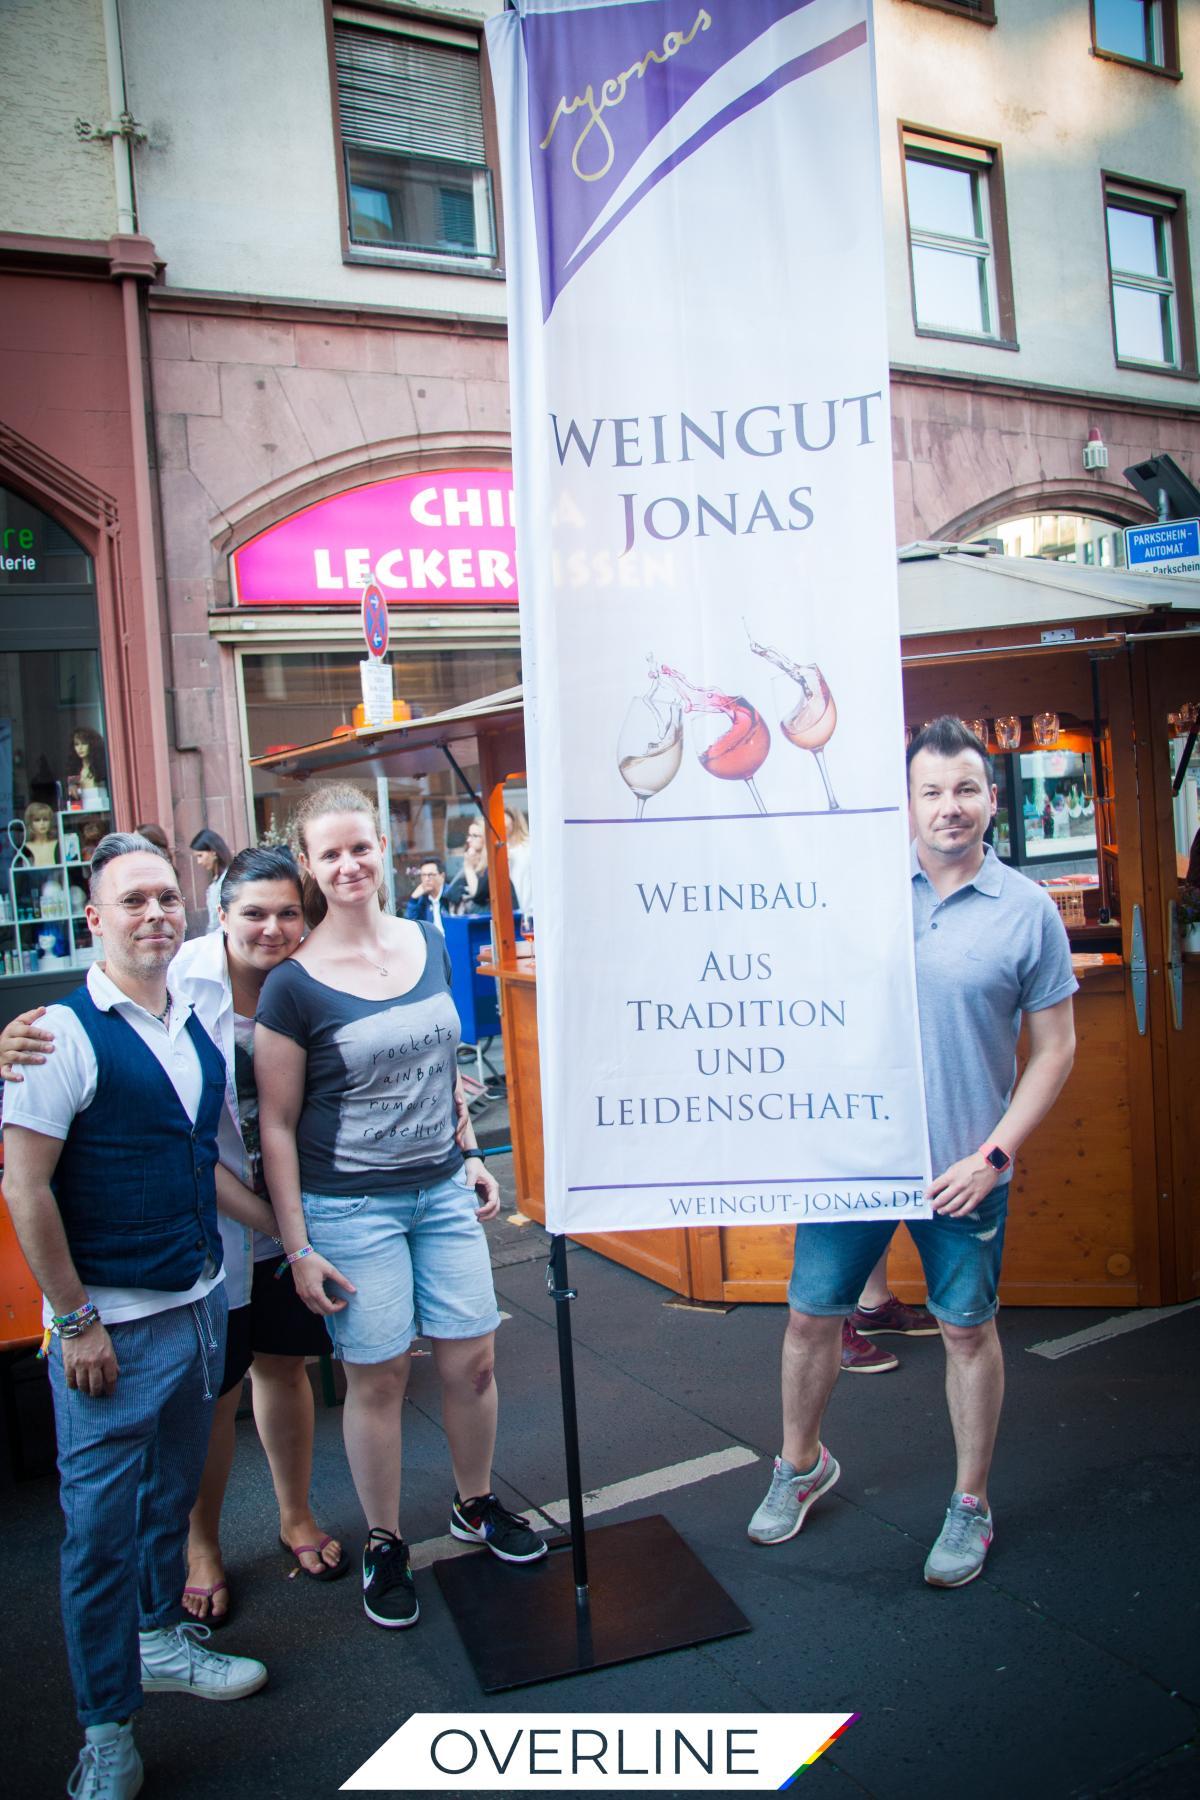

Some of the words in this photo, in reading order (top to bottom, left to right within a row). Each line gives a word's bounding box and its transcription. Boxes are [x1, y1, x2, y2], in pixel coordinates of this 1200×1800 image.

[547, 390, 883, 468] WEINGUT
[617, 486, 815, 559] JONAS
[1133, 528, 1193, 546] PARKSCHEIN-
[1144, 542, 1184, 559] AUTOMAT
[634, 881, 828, 915] WEINBAU.
[698, 950, 773, 982] AUS
[626, 999, 846, 1032] TRADITION
[372, 1023, 453, 1065] rockets
[696, 1046, 786, 1076] UND
[594, 1092, 891, 1127] LEIDENSCHAFT.
[668, 1190, 924, 1216] WEINGUT-JONAS.DE
